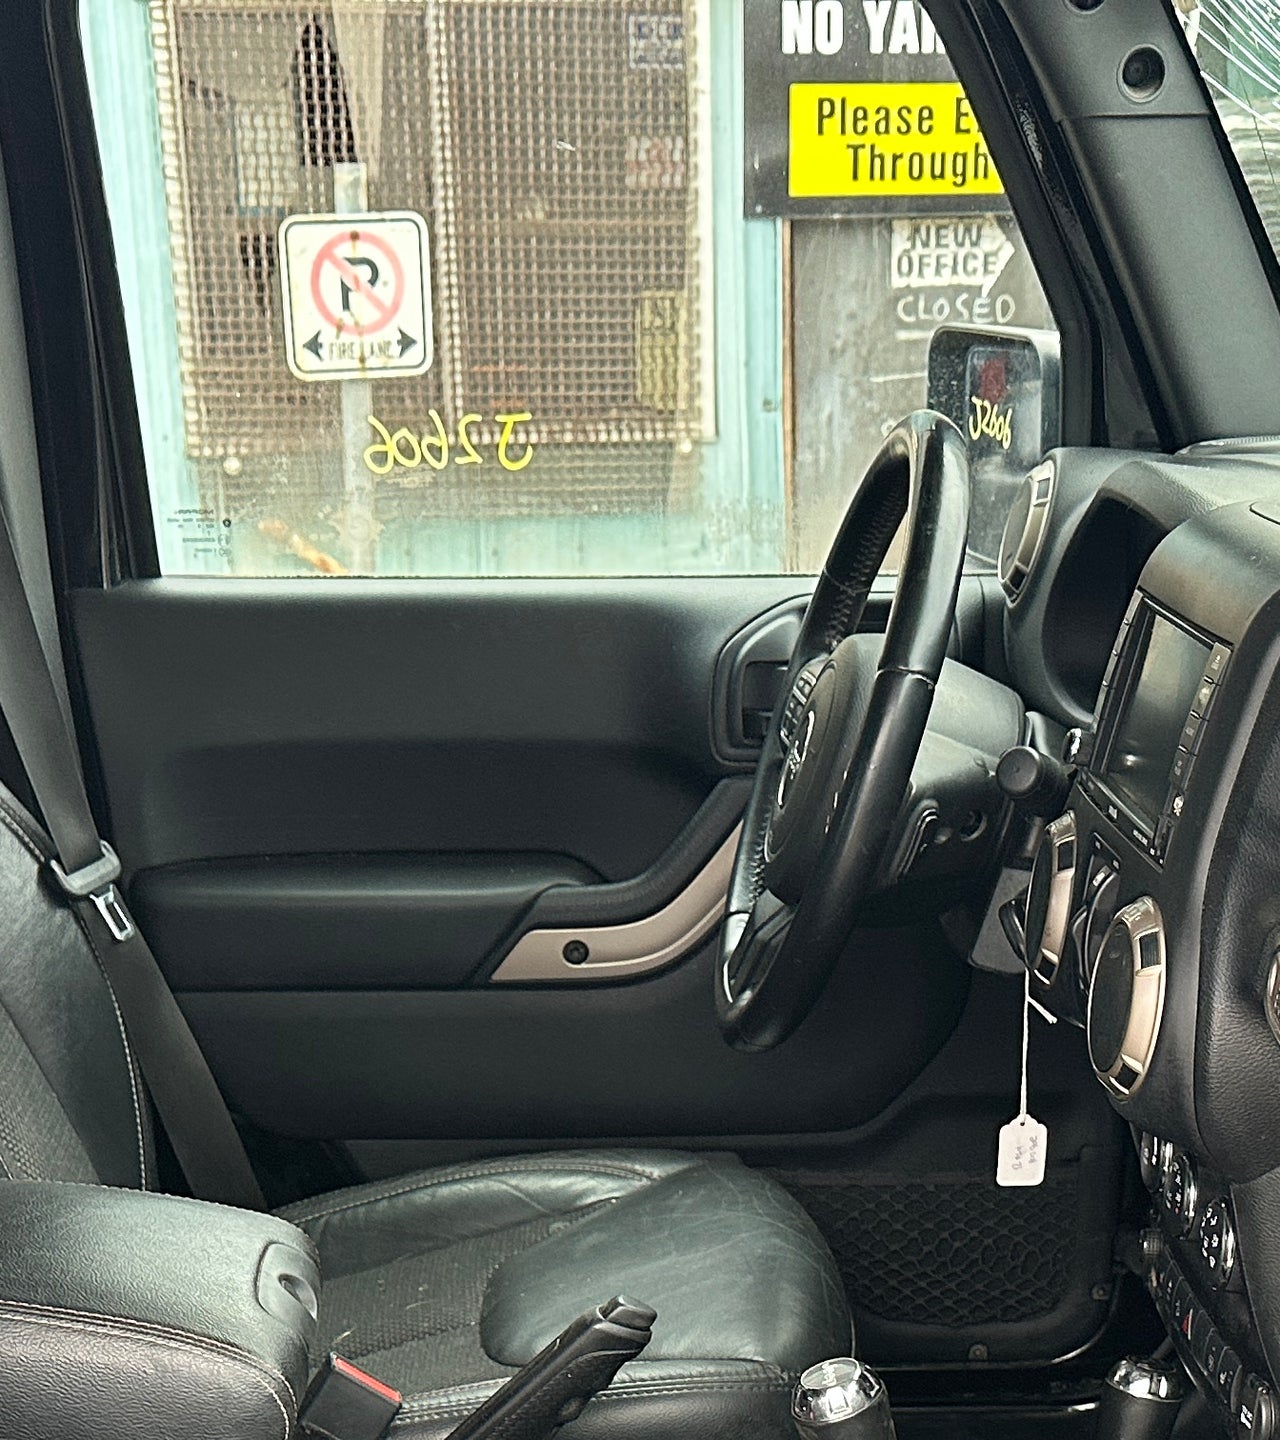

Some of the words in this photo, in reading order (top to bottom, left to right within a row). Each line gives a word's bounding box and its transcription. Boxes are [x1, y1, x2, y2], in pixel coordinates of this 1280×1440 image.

[781, 0, 844, 54] NO
[817, 97, 934, 136] Please
[955, 97, 982, 135] E
[847, 143, 988, 187] Through
[910, 224, 982, 249] NEW
[897, 251, 1000, 278] OFFICE
[897, 292, 1016, 324] CLOSED
